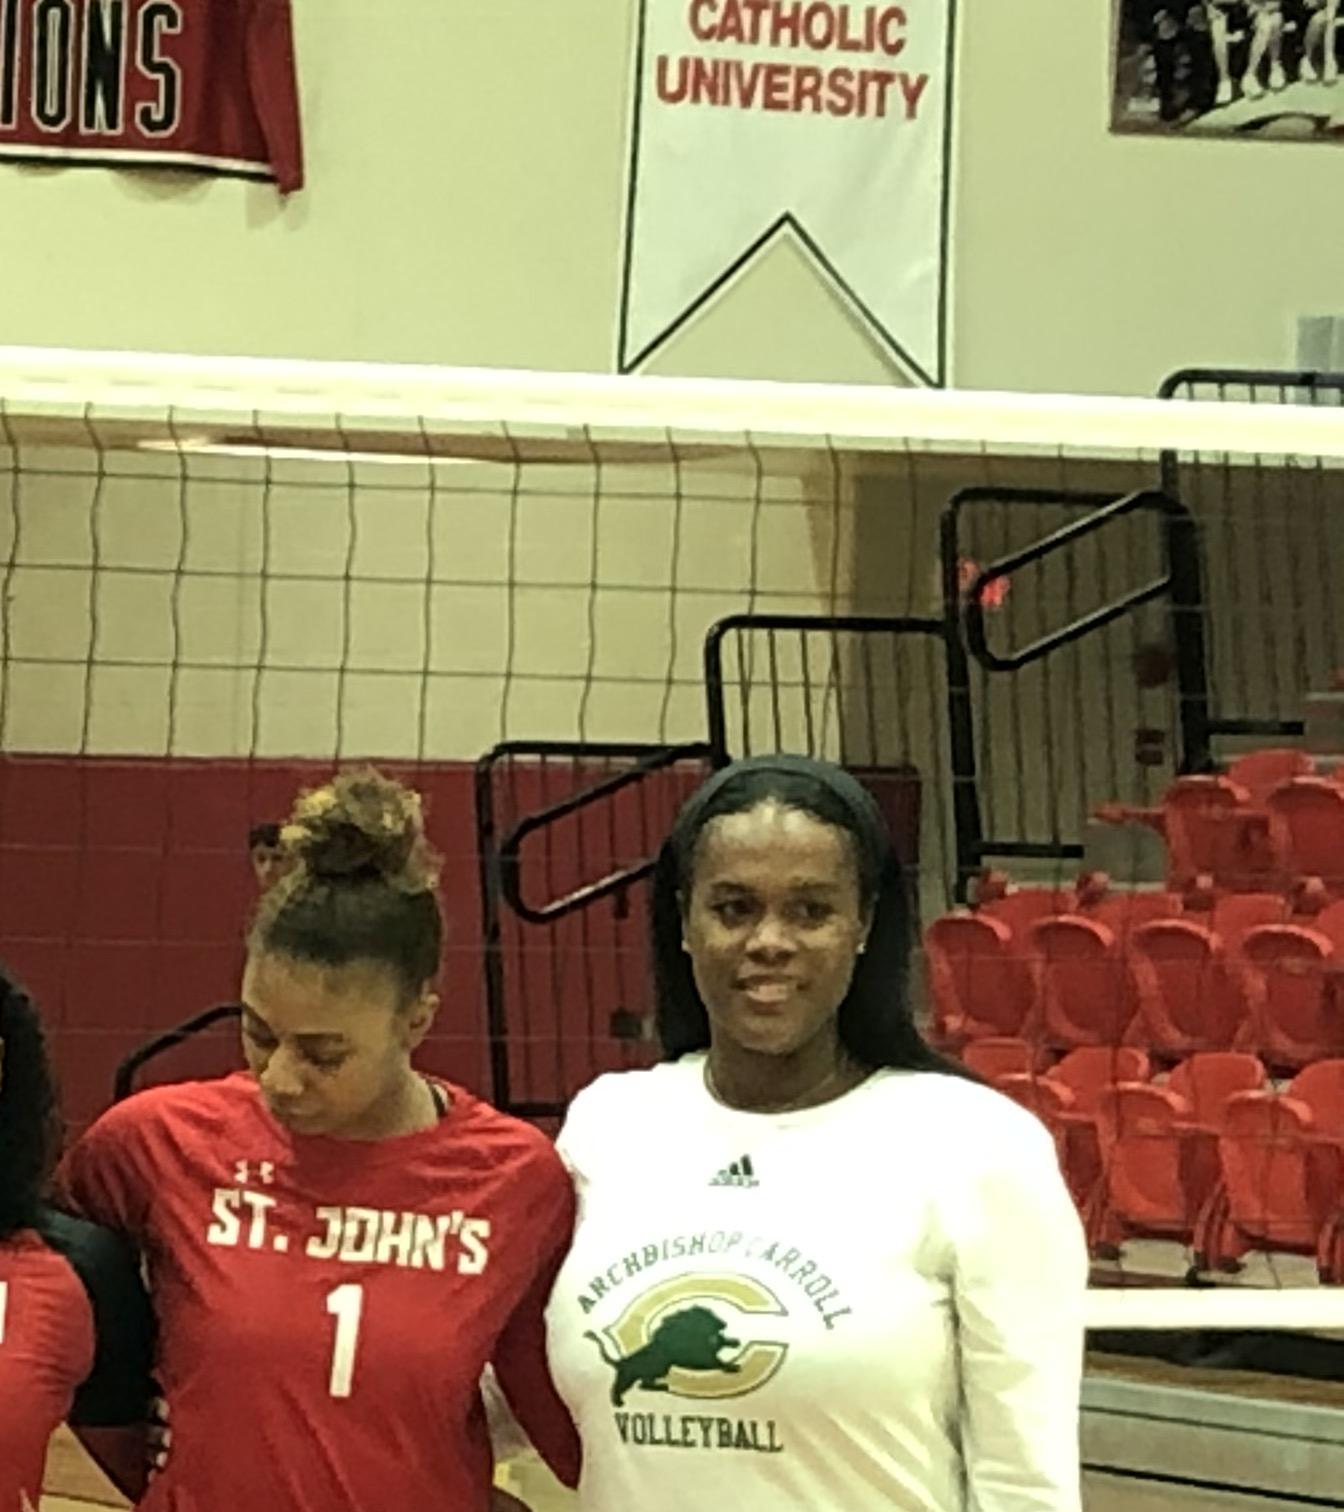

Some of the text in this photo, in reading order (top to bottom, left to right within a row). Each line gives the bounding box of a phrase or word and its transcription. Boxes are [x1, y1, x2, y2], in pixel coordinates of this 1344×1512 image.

[688, 0, 907, 56] CATHOLIC
[656, 54, 930, 120] UNIVERSITY
[207, 1187, 491, 1275] ST. JOHN'S
[577, 1230, 743, 1315] ARCHBISHOP
[326, 1283, 363, 1398] 1
[613, 1412, 785, 1454] VOLLEYBALL
